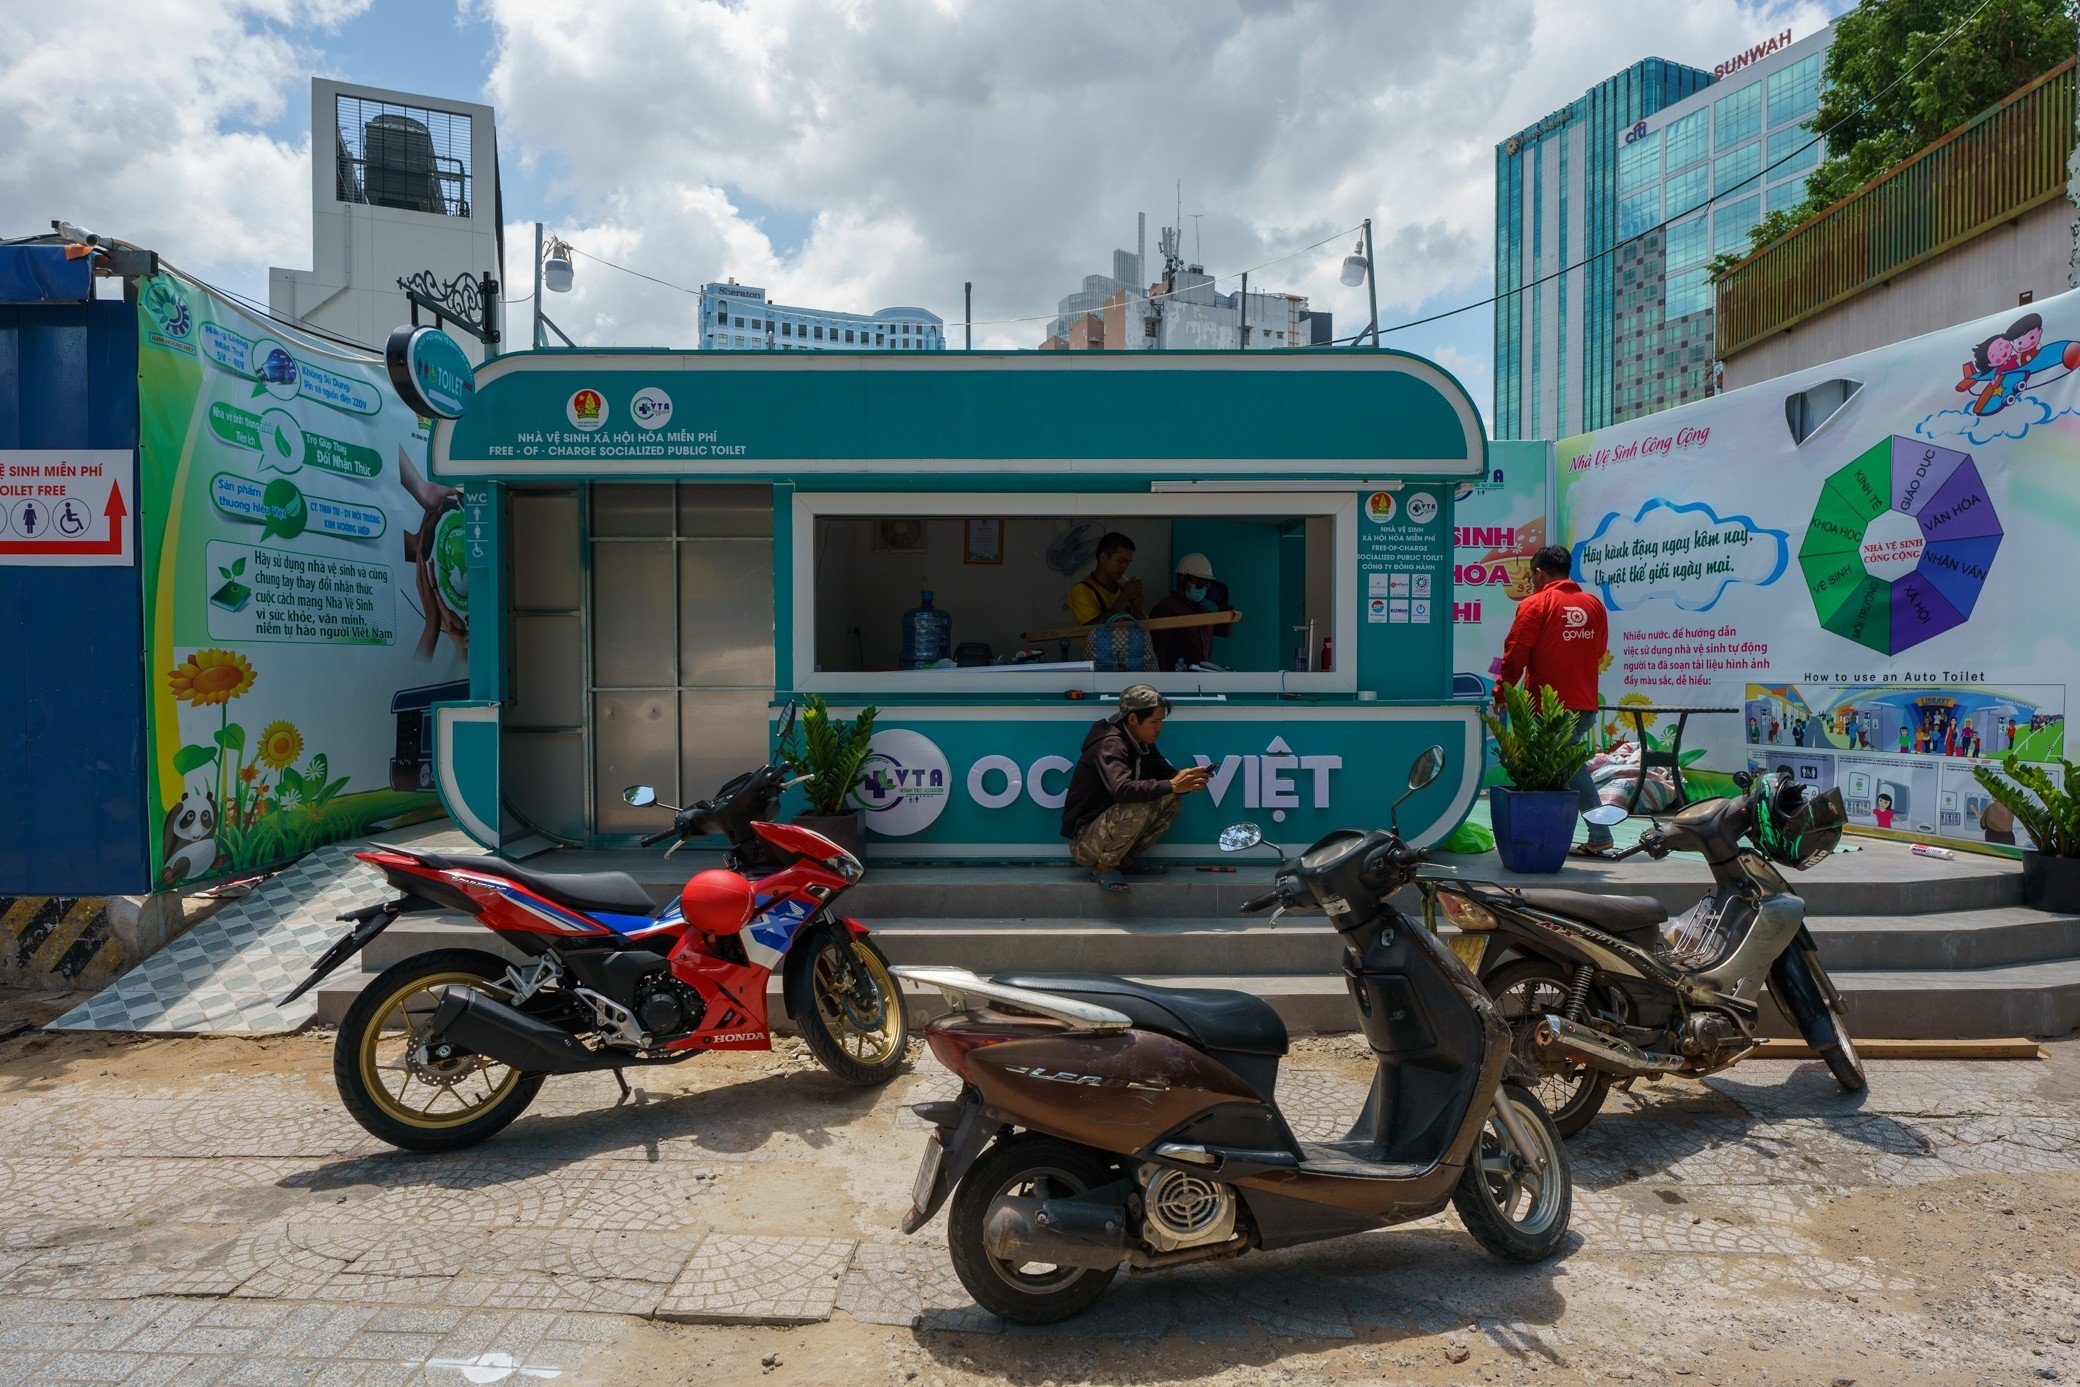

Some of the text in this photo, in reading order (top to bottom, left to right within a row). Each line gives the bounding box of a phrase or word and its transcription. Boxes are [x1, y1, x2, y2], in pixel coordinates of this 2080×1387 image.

[1714, 28, 1792, 80] SUNWAH
[1625, 122, 1647, 144] citi
[718, 286, 761, 299] Sheraton
[437, 366, 464, 397] TOILET
[651, 403, 670, 411] VTA
[518, 428, 718, 446] NHÀ VỆ SINH XÃ HỘI HÓA MIỄN PHÍ
[333, 441, 347, 455] Thay
[489, 445, 747, 457] FREE OF CHARGE SOCIALIZED PUBLIC TOILET
[1569, 427, 1711, 471] Nhà Vệ Sinh Công Cộng
[9, 466, 40, 477] SINH
[44, 461, 76, 477] MIỄN
[80, 463, 103, 477] PHÍ
[1853, 469, 1873, 497] KINH
[1900, 449, 1937, 511] GIÁO DỤC
[0, 485, 66, 496] OILET FREE
[466, 493, 488, 503] WC
[1924, 493, 1982, 532] VĂN HÓA
[1380, 525, 1396, 533] NHÀ
[1388, 533, 1405, 542] HÓA
[1424, 534, 1436, 542] PHÍ
[1453, 526, 1515, 548] SINH
[1810, 516, 1863, 544] KHOA HỌC
[1583, 529, 1753, 565] Hãy hành động ngay hôm nay.
[1863, 538, 1924, 553] NHÀ VỆ SINH
[1357, 553, 1396, 561] SOCIALIZED
[1397, 553, 1421, 561] PUBLIC
[1863, 550, 1921, 564] CÔNG CỘNG
[254, 550, 271, 569] Hãy
[284, 556, 306, 574] dụng
[307, 560, 326, 573] nhà
[327, 563, 338, 578] vệ
[339, 564, 357, 578] sinh
[358, 567, 367, 579] và
[369, 568, 388, 583] cùng
[1362, 562, 1383, 570] CÔNG
[1416, 562, 1436, 571] HÀNH
[1594, 554, 1735, 589] Vì một thế giới ngày mai.
[1923, 550, 1988, 582] NHÂN VĂN
[255, 570, 374, 596] chung tay thay đổi nhận thức
[1829, 564, 1853, 587] SINH
[255, 590, 374, 613] cuộc cách mạng Nhà Vệ Sinh
[256, 607, 266, 620] vì
[269, 609, 286, 622] sức
[318, 613, 338, 625] văn
[341, 613, 367, 627] minh,
[1453, 599, 1482, 622] HÍ
[283, 624, 294, 638] tự
[296, 623, 317, 637] hào
[319, 625, 350, 640] người
[351, 627, 370, 640] Việt
[371, 628, 393, 640] Nam
[1562, 629, 1595, 641] goviet
[1717, 624, 1737, 638] dẫn
[1623, 641, 1768, 658] việc dụng nhà vệ sinh tự động
[1623, 656, 1770, 673] người ta đã soạn tài liệu hình ảnh
[1640, 675, 1658, 686] màu
[1804, 671, 1985, 682] How to use an Auto Toilet
[895, 769, 944, 787] VTA
[1193, 735, 1343, 823] VIỆT
[713, 1032, 766, 1043] HONDA
